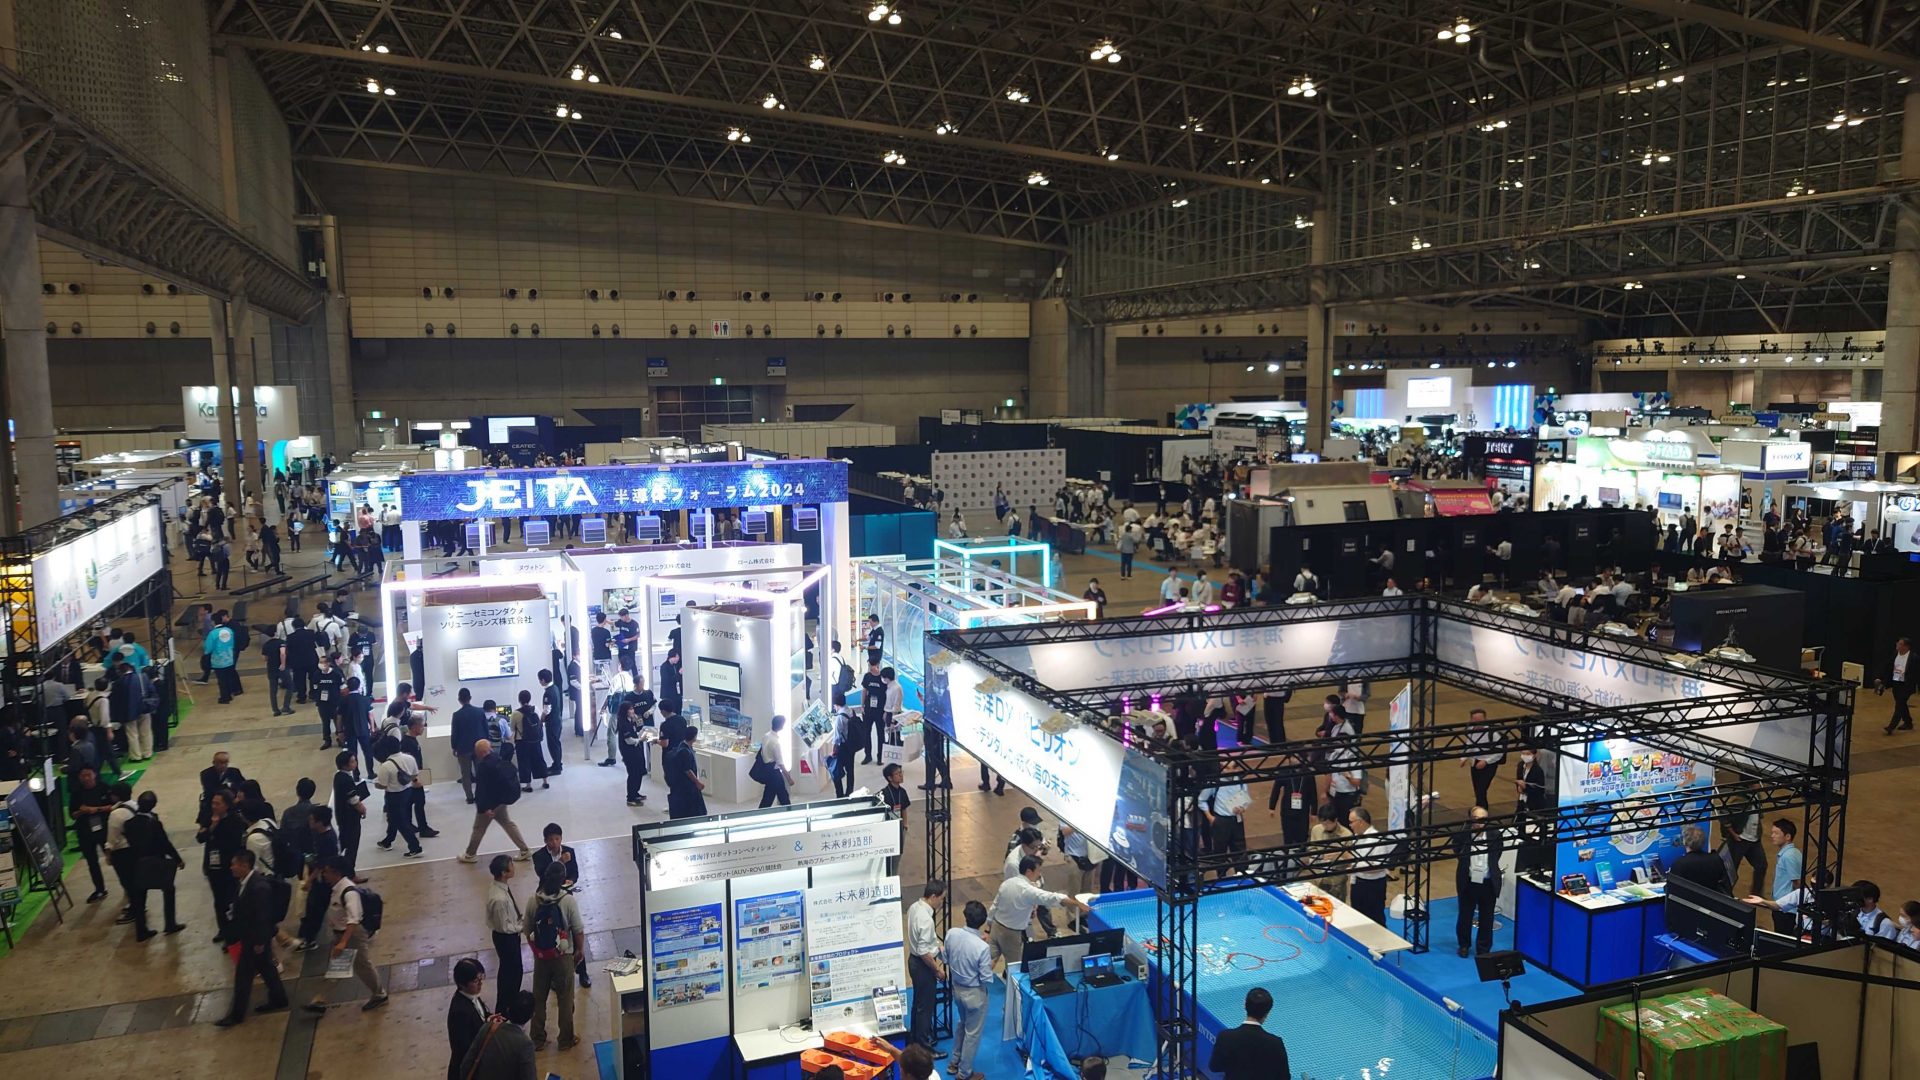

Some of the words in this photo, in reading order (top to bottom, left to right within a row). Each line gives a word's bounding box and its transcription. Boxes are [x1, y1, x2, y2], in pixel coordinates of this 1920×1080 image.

[455, 477, 599, 512] JEITA
[614, 482, 805, 505] 半導体フォーラム2024
[737, 557, 775, 565] ローム株式会社
[794, 840, 803, 851] &
[821, 835, 873, 851] 未来創造部
[835, 884, 895, 903] 未来創造部
[1198, 1022, 1217, 1046] INTE
